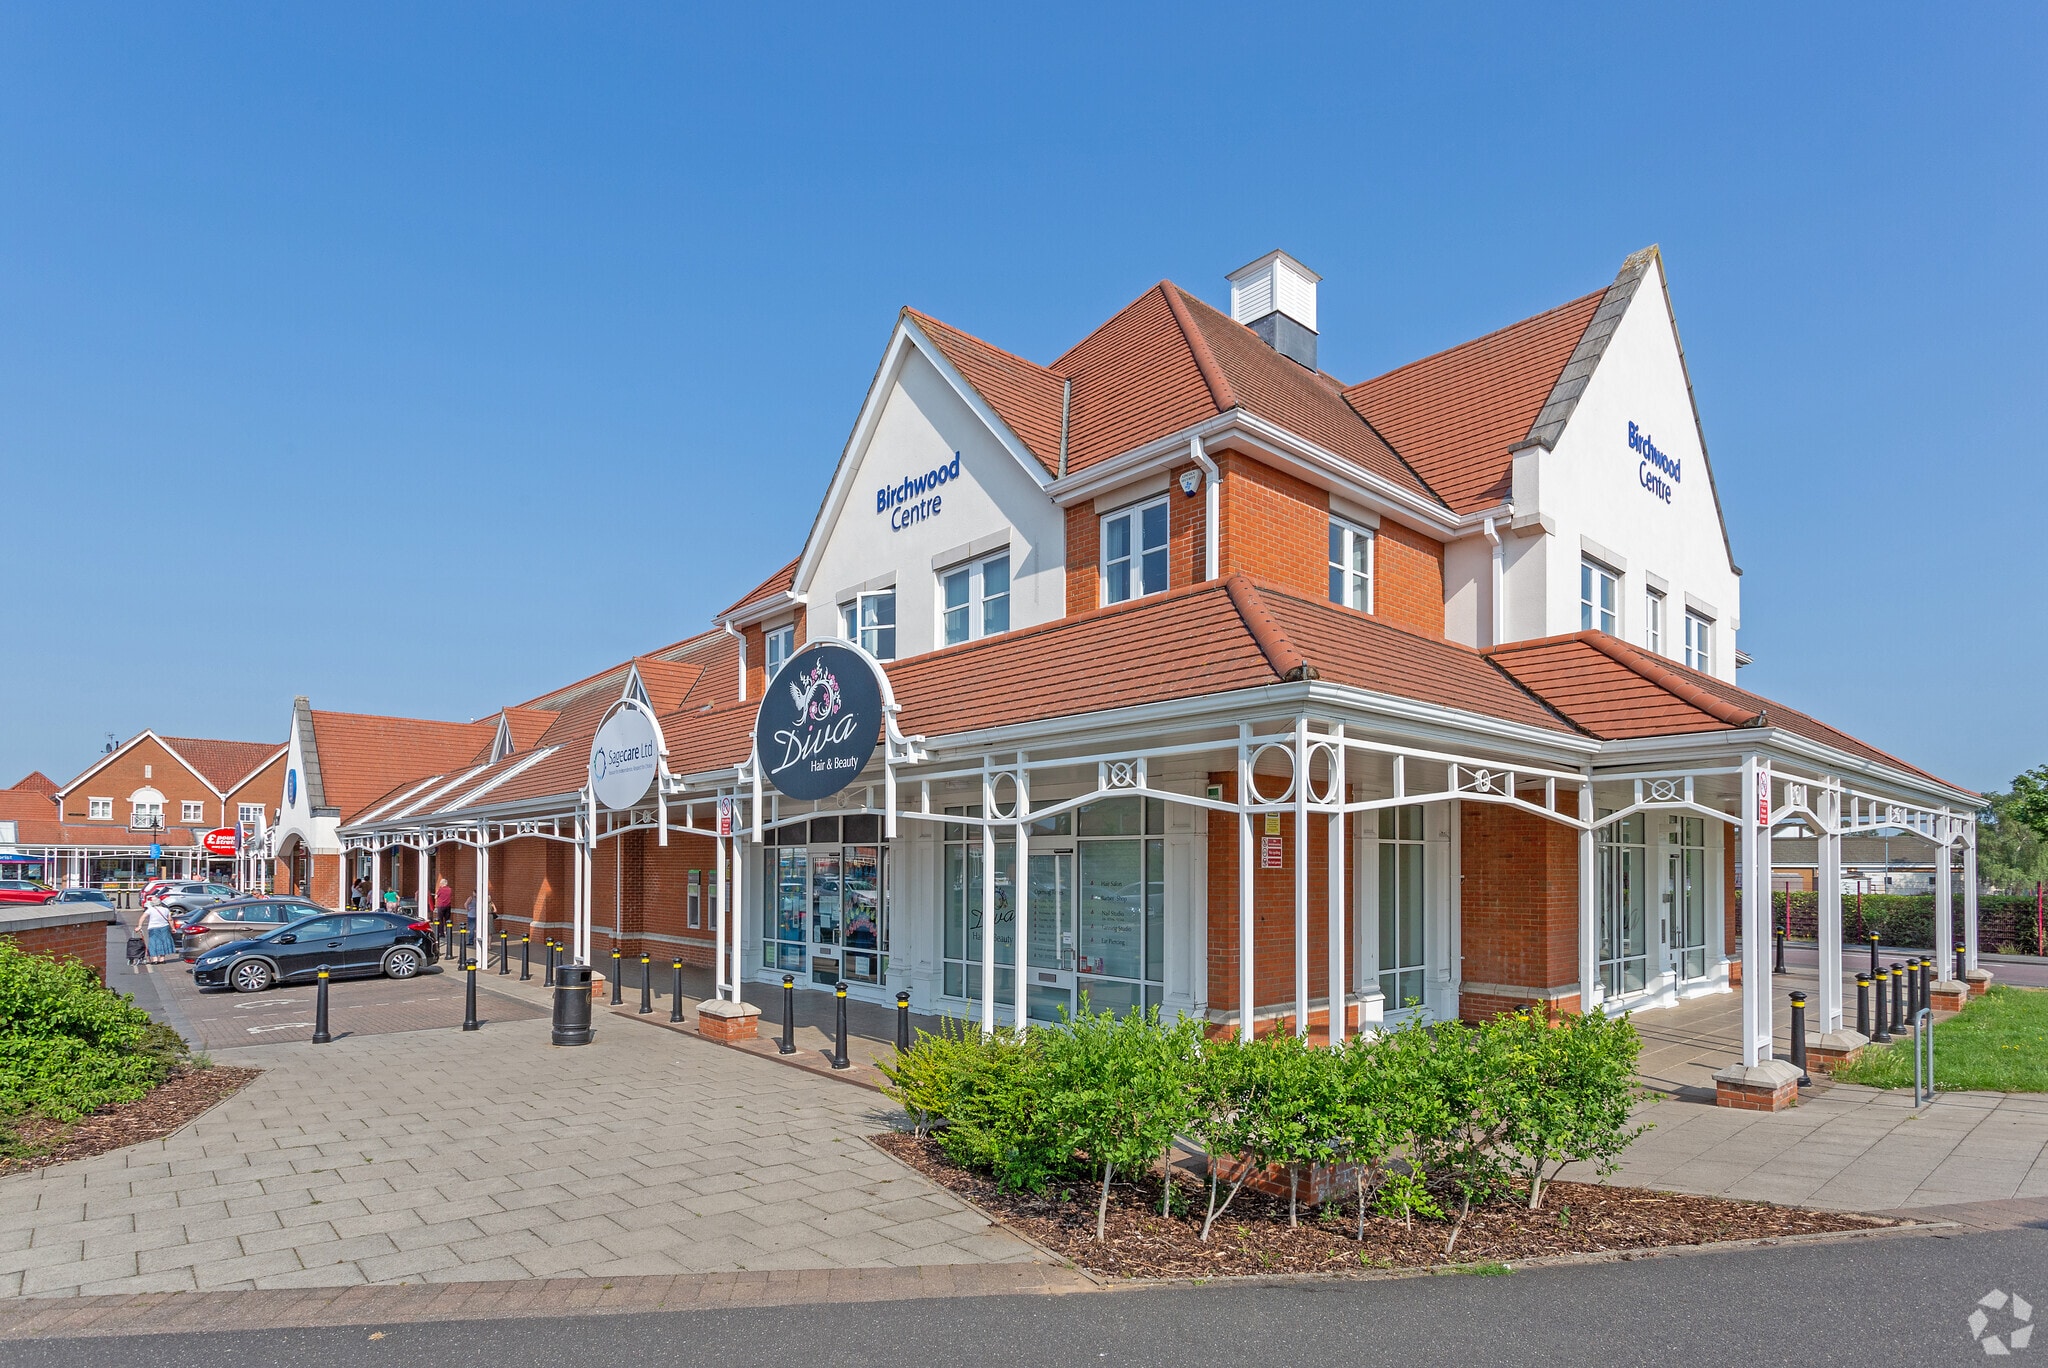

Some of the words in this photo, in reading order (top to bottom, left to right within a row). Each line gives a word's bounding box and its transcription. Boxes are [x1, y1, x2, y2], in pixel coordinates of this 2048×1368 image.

[1628, 420, 1681, 484] Birchwood
[876, 450, 960, 514] Birchwood
[1639, 460, 1672, 505] Centre
[891, 495, 942, 531] Centre
[608, 746, 640, 768] Sagecare
[641, 739, 653, 759] Ltd
[771, 713, 858, 775] Diva
[810, 759, 826, 772] Hair
[826, 758, 833, 770] &
[834, 756, 859, 771] Beauty
